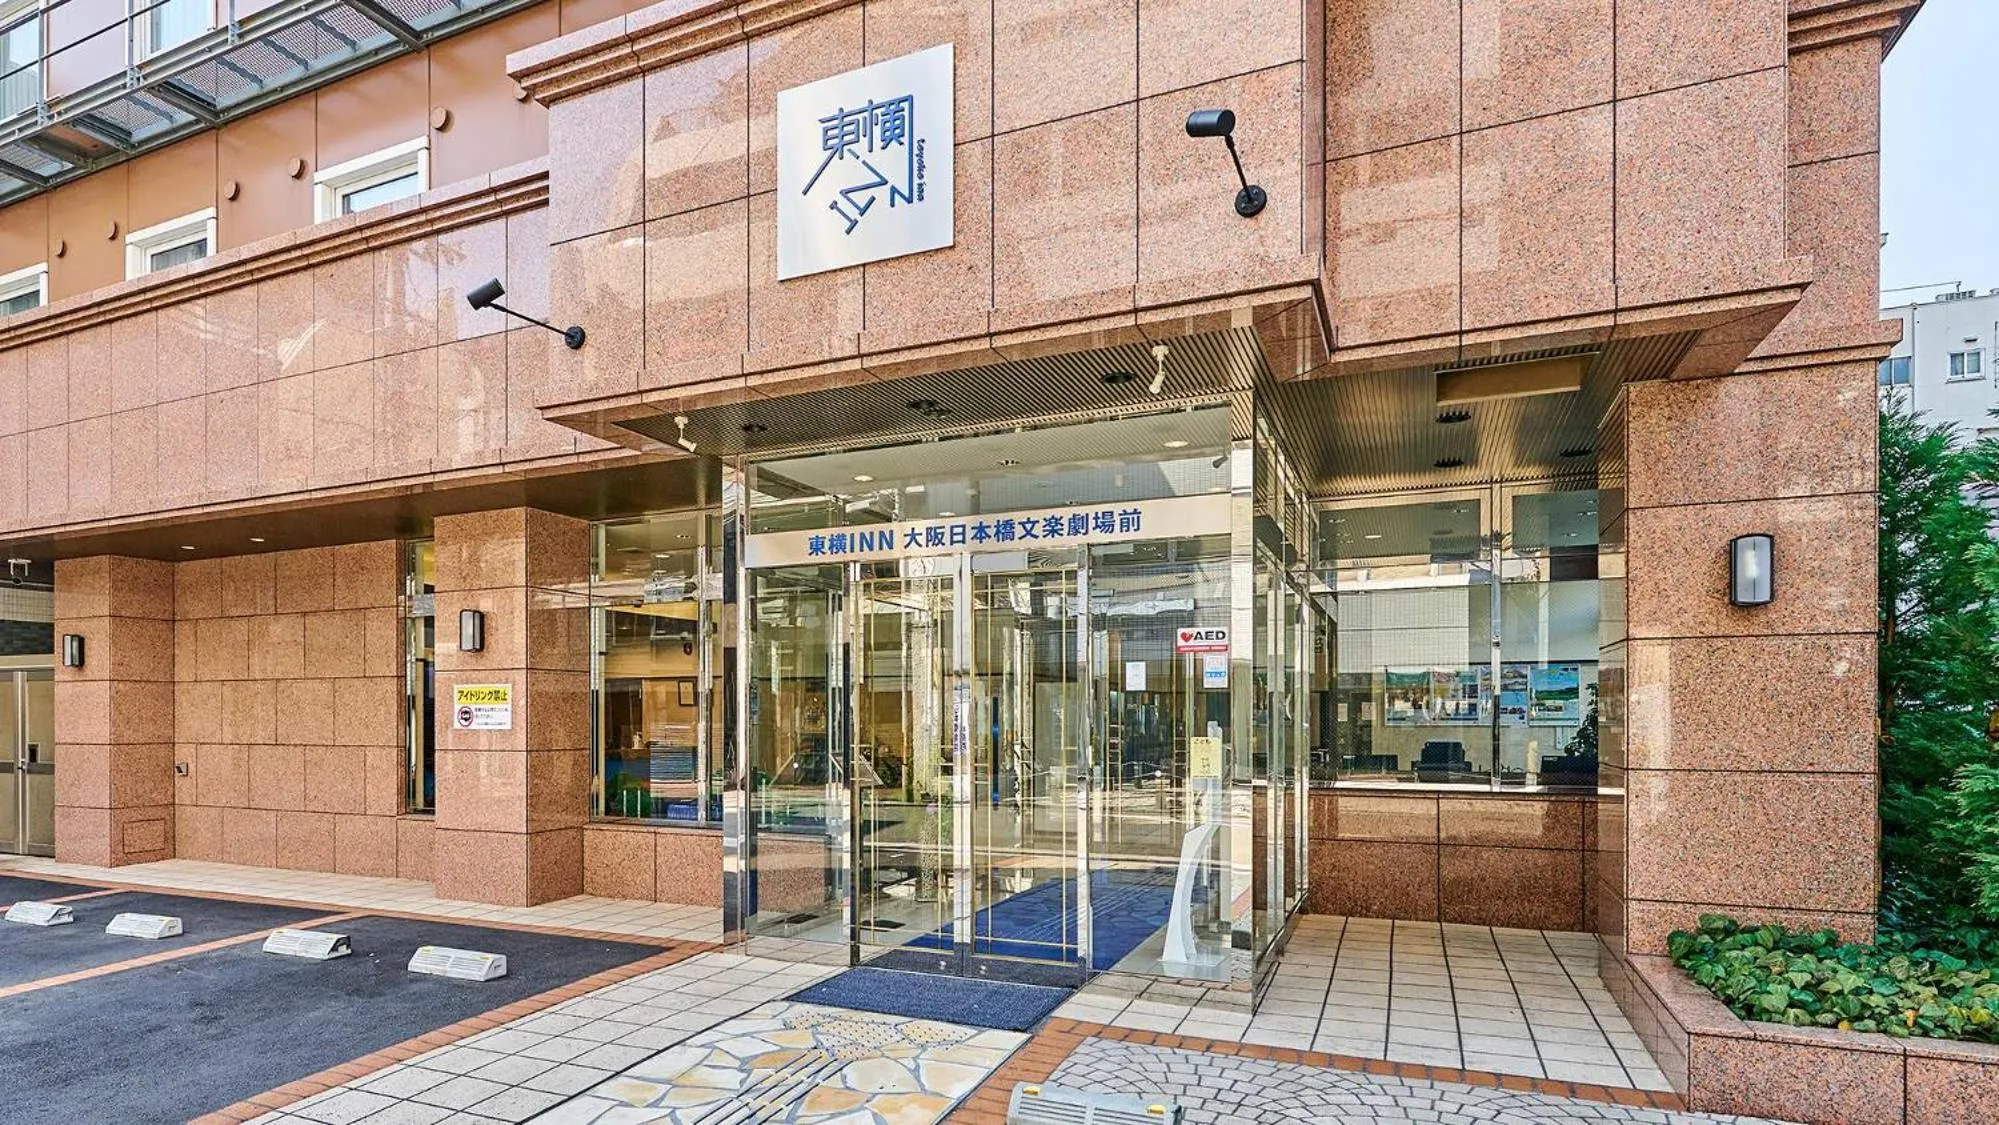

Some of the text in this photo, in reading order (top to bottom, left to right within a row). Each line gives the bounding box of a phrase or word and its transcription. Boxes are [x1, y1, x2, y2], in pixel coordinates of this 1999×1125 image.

[916, 138, 926, 202] toyoko inn
[808, 508, 1143, 557] 東横INN 大阪日本橋文楽劇場前
[1193, 630, 1226, 641] AED
[457, 690, 508, 702] アイドリング禁止
